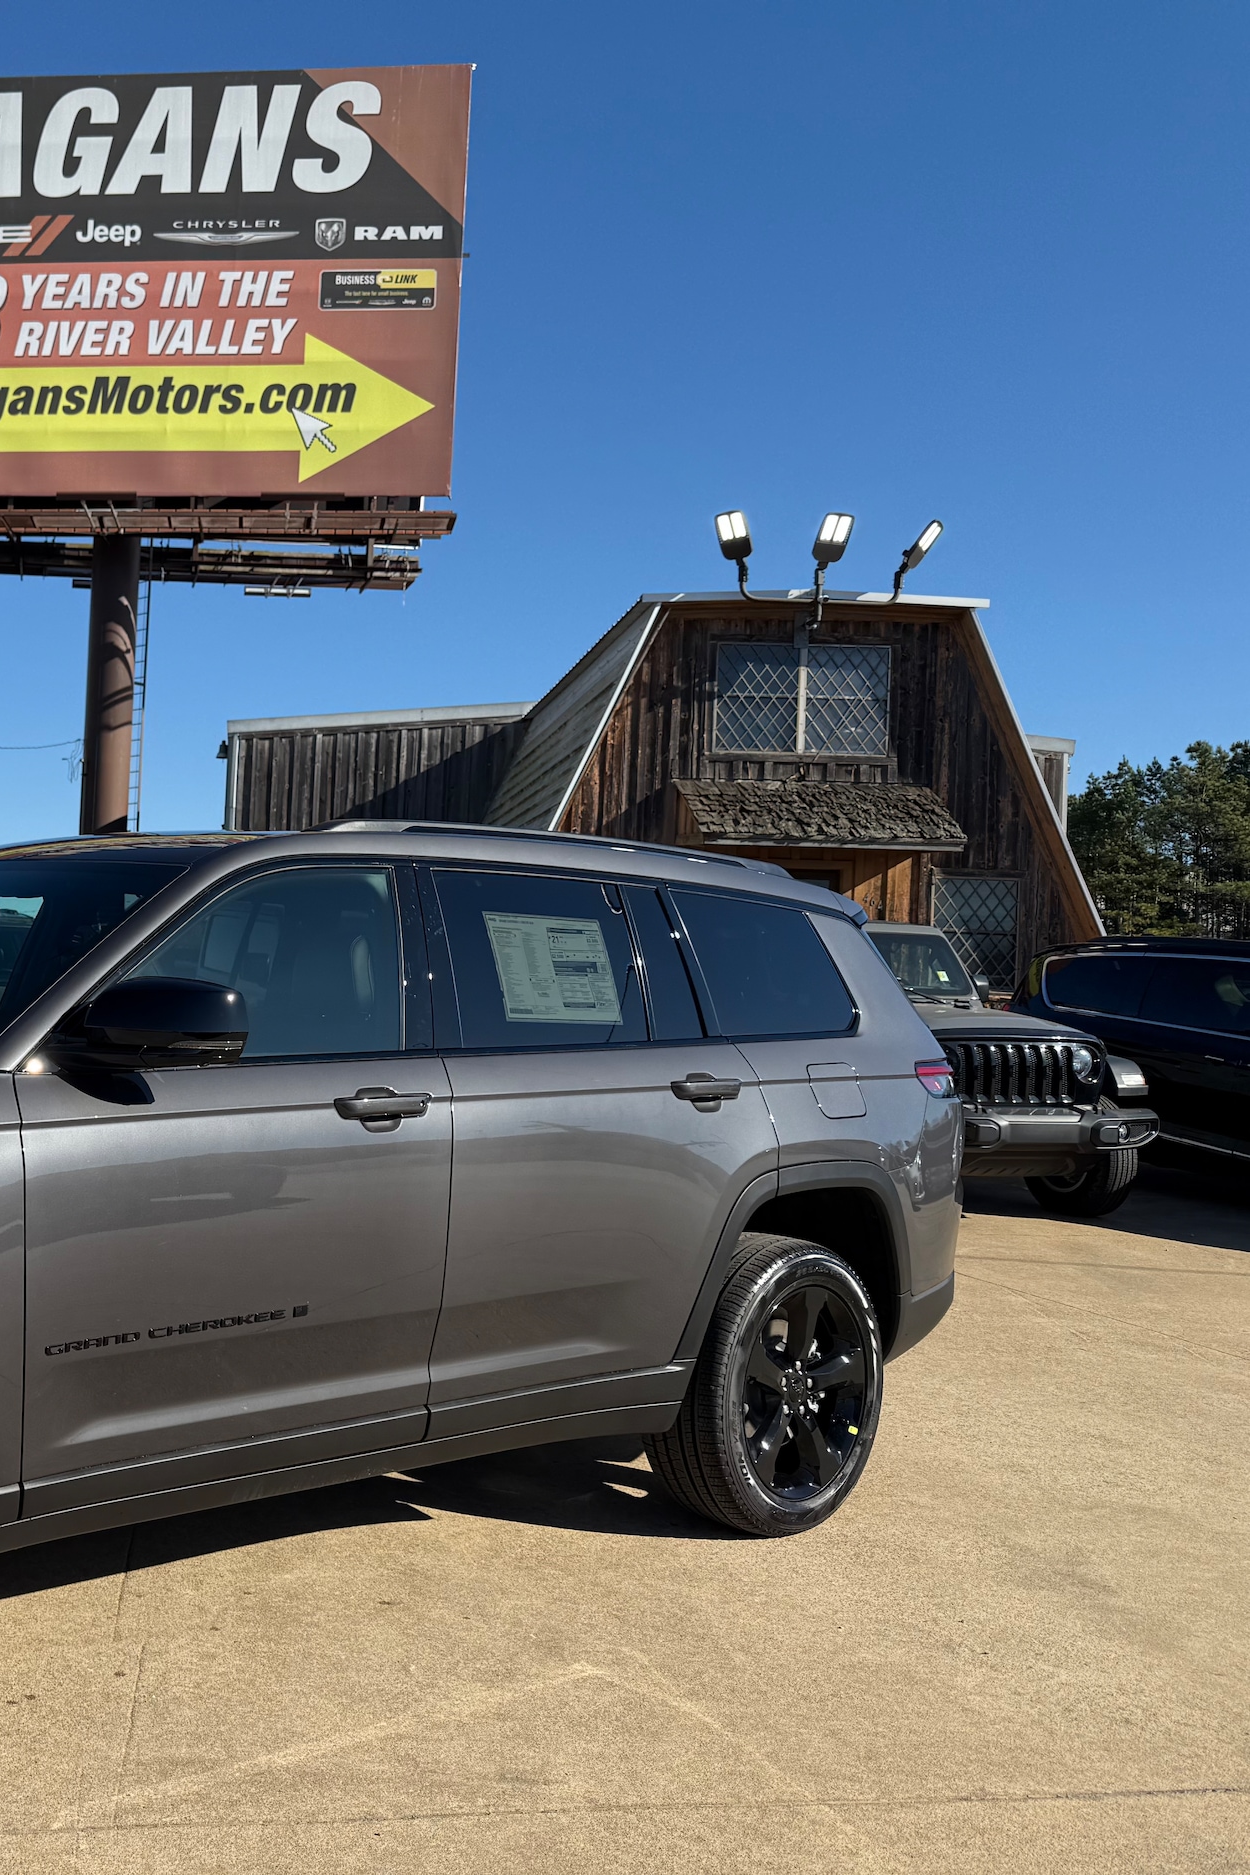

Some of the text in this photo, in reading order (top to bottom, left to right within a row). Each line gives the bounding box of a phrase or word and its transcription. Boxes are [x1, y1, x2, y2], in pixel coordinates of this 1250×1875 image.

[76, 219, 141, 247] Jeep
[172, 219, 281, 229] CHRYSLER
[353, 225, 443, 241] RAM
[21, 270, 294, 310] YEARS IN THE
[335, 274, 418, 285] BUSINESS LINK
[14, 318, 299, 357] RIVER VALLEY
[44, 1331, 140, 1357] GRAND
[148, 1309, 286, 1339] CHEROKEE
